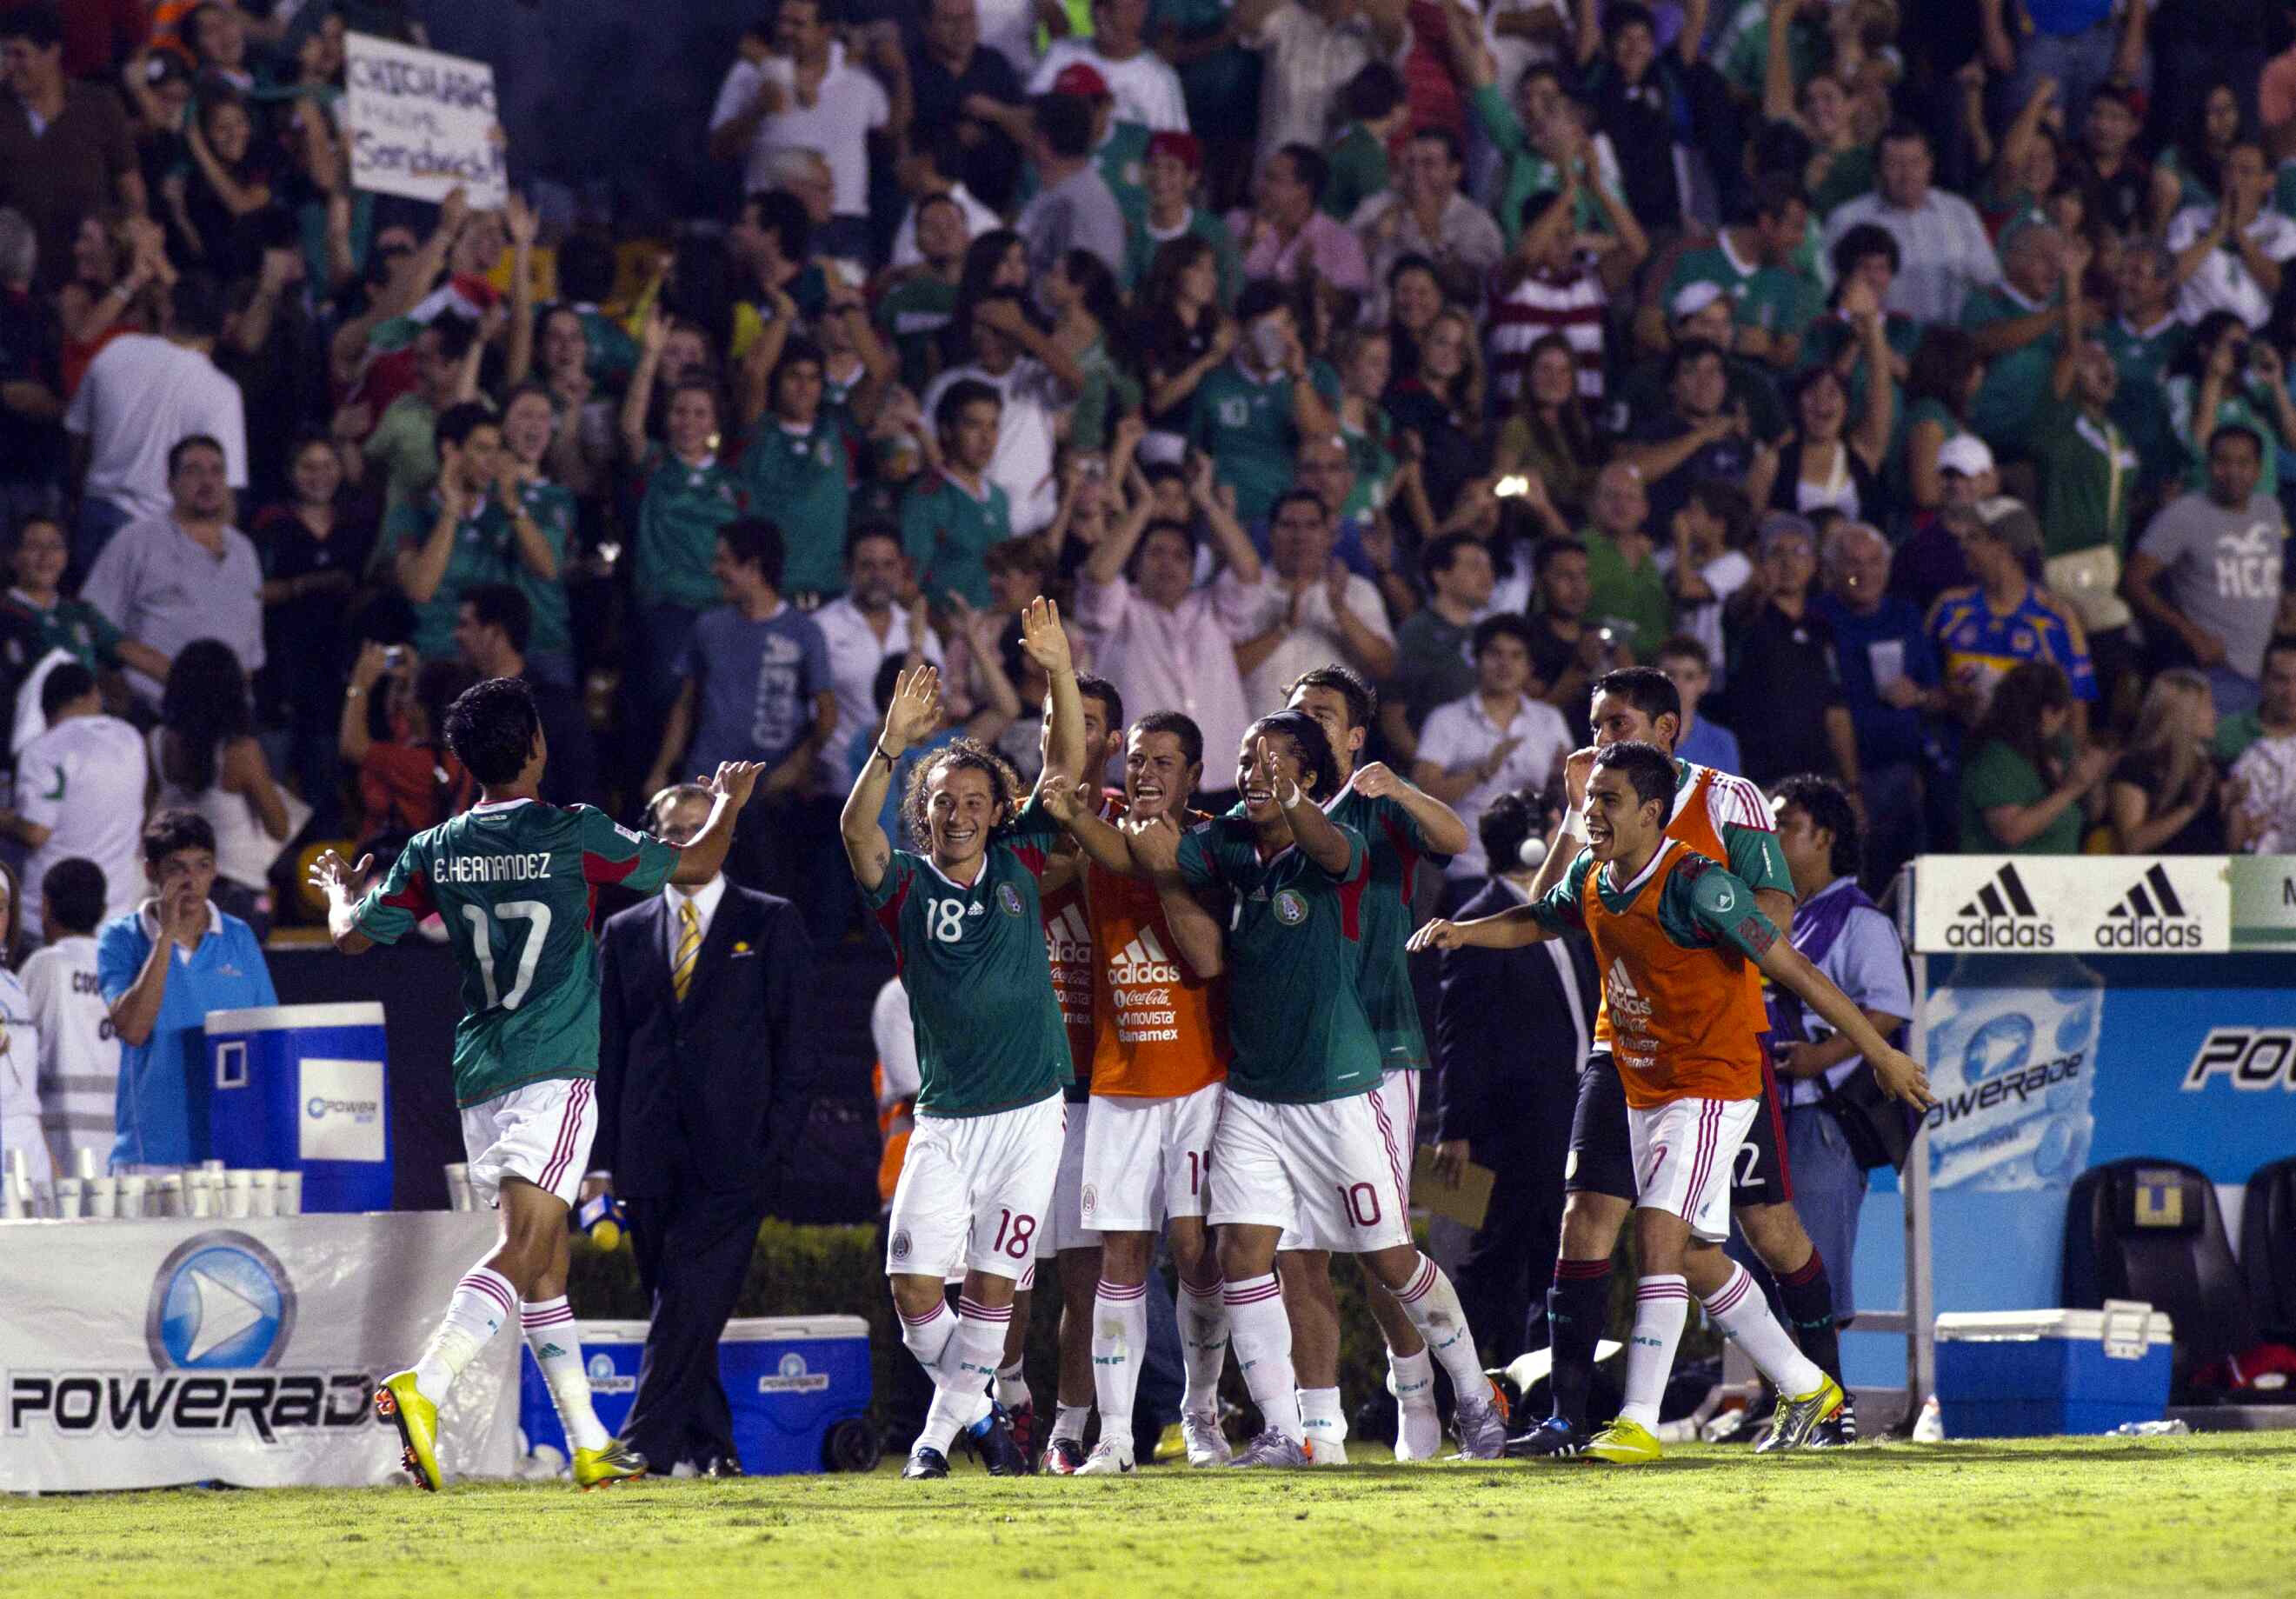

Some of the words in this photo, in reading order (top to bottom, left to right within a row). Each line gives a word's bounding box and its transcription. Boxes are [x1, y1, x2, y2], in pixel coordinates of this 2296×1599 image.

[434, 852, 551, 883] E.HERNANDEZ
[926, 897, 966, 943] 18
[1945, 916, 2055, 949] adidas
[2094, 916, 2204, 949] adidas
[462, 900, 552, 1010] 17
[1046, 939, 1092, 963] dida
[1108, 961, 1181, 986] adidas
[1119, 1029, 1179, 1043] Banamex
[2191, 1035, 2296, 1083] PO
[1336, 1182, 1382, 1228] 10
[992, 1209, 1037, 1260] 18
[960, 1362, 995, 1376] FM
[1093, 1356, 1126, 1365] MF
[12, 1376, 393, 1443] POWERAD
